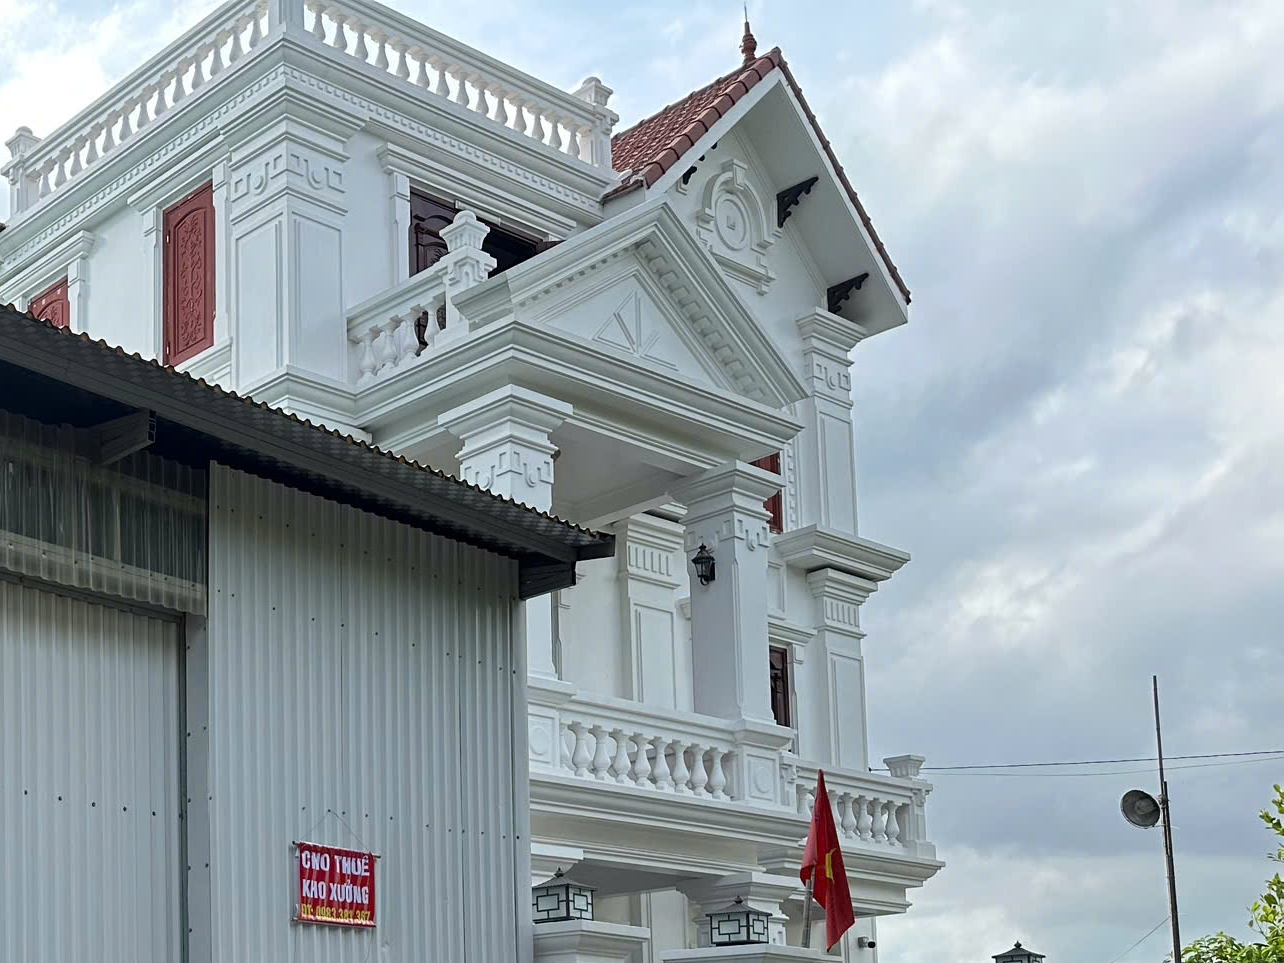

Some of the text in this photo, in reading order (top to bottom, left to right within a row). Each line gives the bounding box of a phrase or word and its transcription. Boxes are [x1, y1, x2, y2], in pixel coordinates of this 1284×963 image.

[301, 850, 370, 876] CHO THUÊ
[302, 879, 369, 904] KHO XƯỞNG
